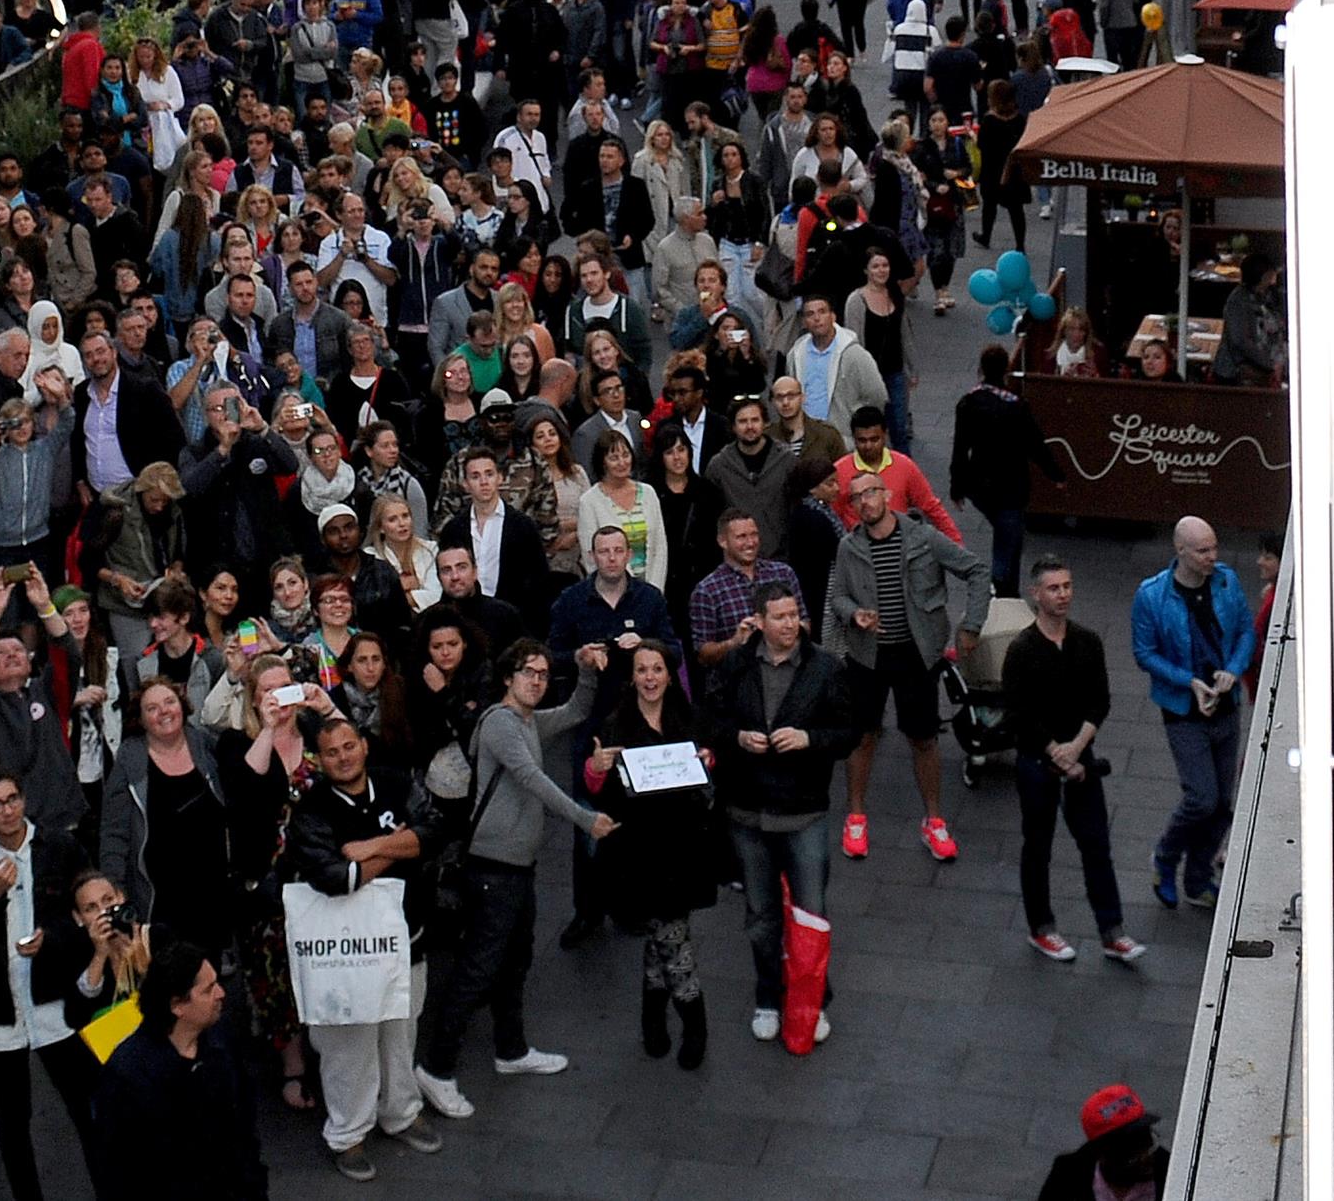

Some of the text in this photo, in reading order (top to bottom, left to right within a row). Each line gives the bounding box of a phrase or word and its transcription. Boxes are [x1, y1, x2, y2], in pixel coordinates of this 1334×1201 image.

[1040, 159, 1159, 186] Bella Italia
[1109, 414, 1221, 445] Leicester
[1124, 438, 1219, 474] Square
[294, 936, 399, 957] SHOP ONLINE
